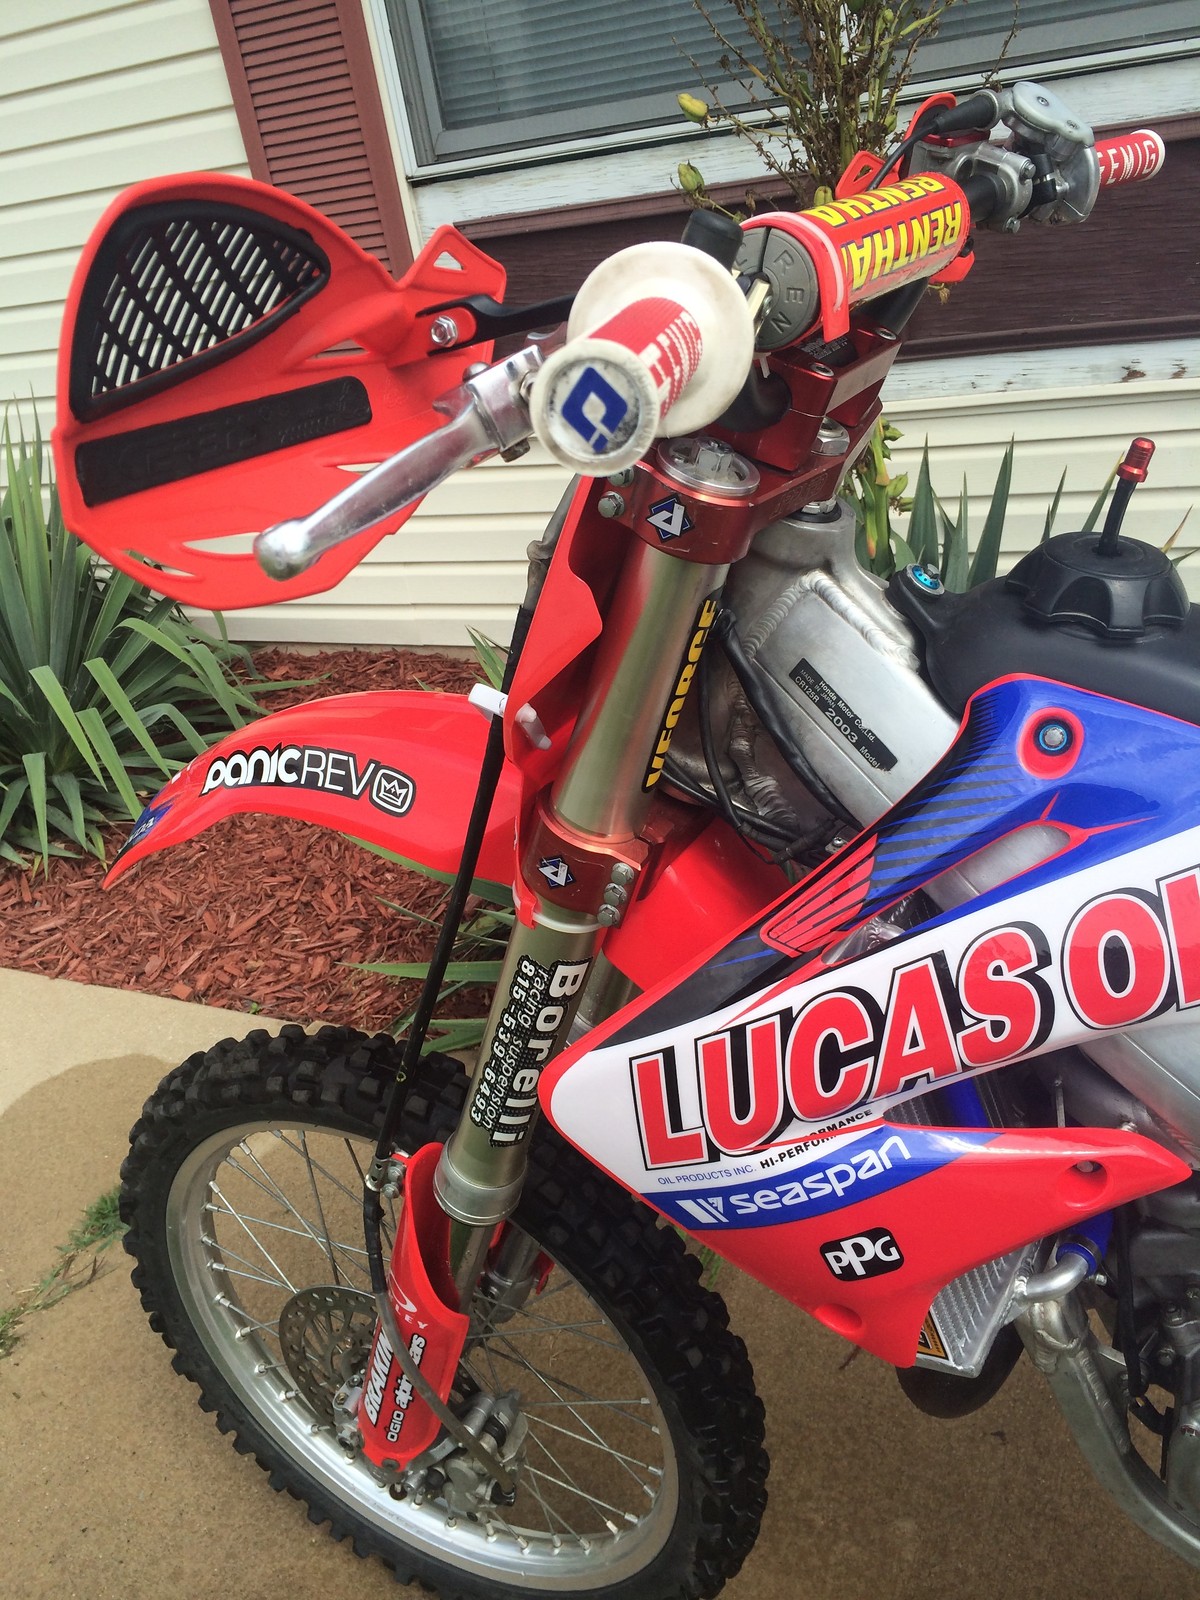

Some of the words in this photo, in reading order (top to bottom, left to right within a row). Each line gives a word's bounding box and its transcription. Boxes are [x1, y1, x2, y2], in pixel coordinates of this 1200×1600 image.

[810, 174, 945, 227] RENTHA
[841, 201, 962, 291] RENTHA
[795, 675, 820, 703] CR125R
[825, 707, 858, 744] 2003
[859, 745, 881, 769] Model
[800, 669, 815, 685] MADE
[814, 684, 821, 692] IN
[820, 692, 836, 708] JAPAN
[818, 680, 837, 701] Honda
[837, 700, 855, 719] Motor
[516, 968, 549, 1029] racing
[629, 920, 1055, 1171] LUCAS
[1060, 863, 1200, 1031] OI
[470, 959, 536, 1123] 815-539-6493
[492, 961, 590, 1142] Borelli
[482, 1036, 523, 1129] suspension
[657, 1176, 676, 1186] OIL
[675, 1168, 733, 1185] PRODUCTS
[733, 1164, 758, 1176] INC.
[729, 1135, 911, 1215] seaspan
[824, 1236, 901, 1276] PPG
[363, 1326, 394, 1426] BRAKIN
[386, 1410, 405, 1443] OGIO
